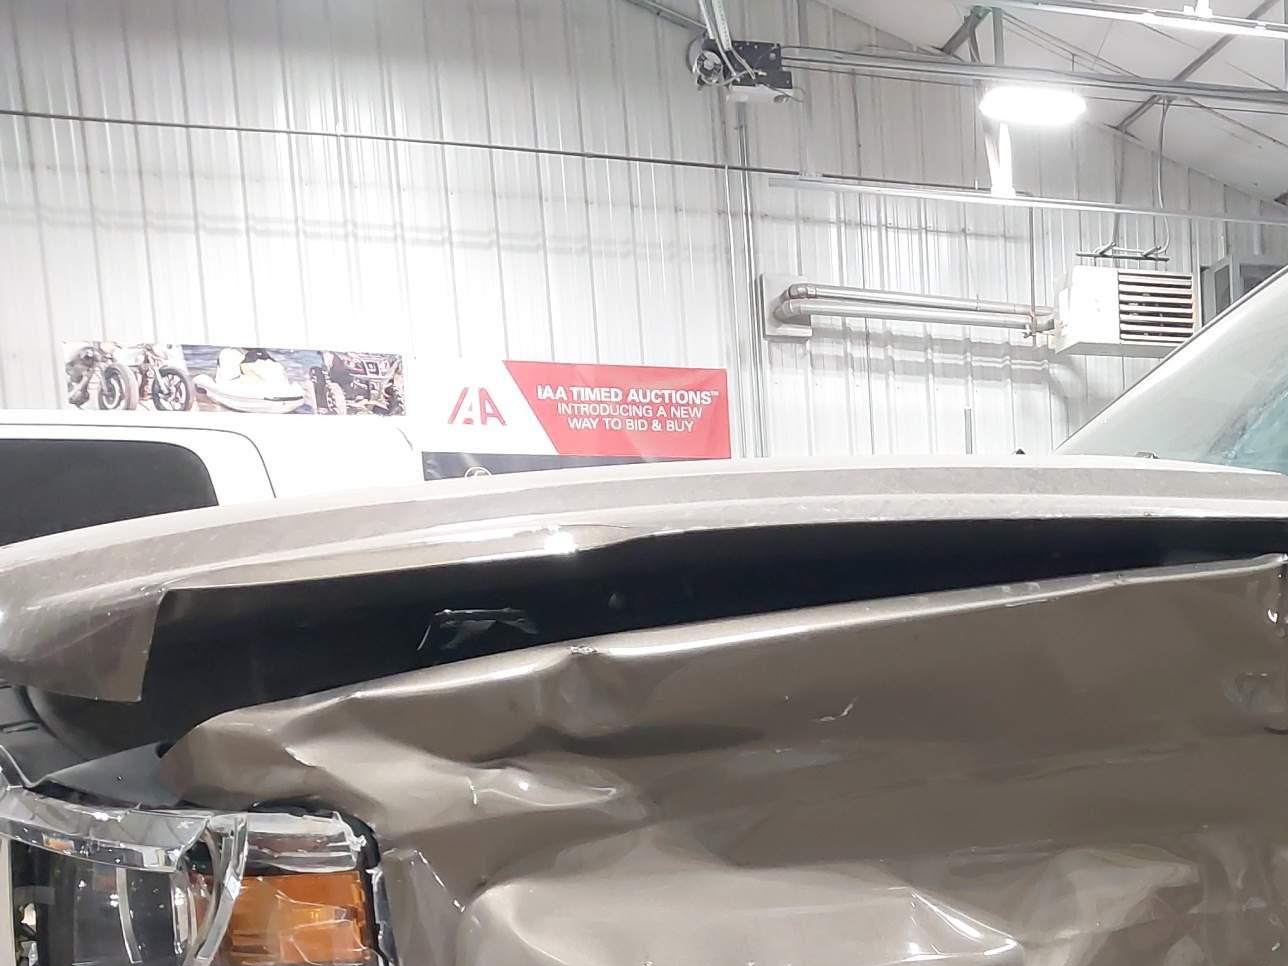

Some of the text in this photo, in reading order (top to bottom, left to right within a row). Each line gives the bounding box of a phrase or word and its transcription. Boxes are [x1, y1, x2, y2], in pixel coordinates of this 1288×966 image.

[537, 385, 567, 400] IAA
[569, 386, 622, 402] TIMED
[557, 402, 703, 418] INTRODUCING A NEW
[567, 416, 694, 433] WAY TO BID & BUY
